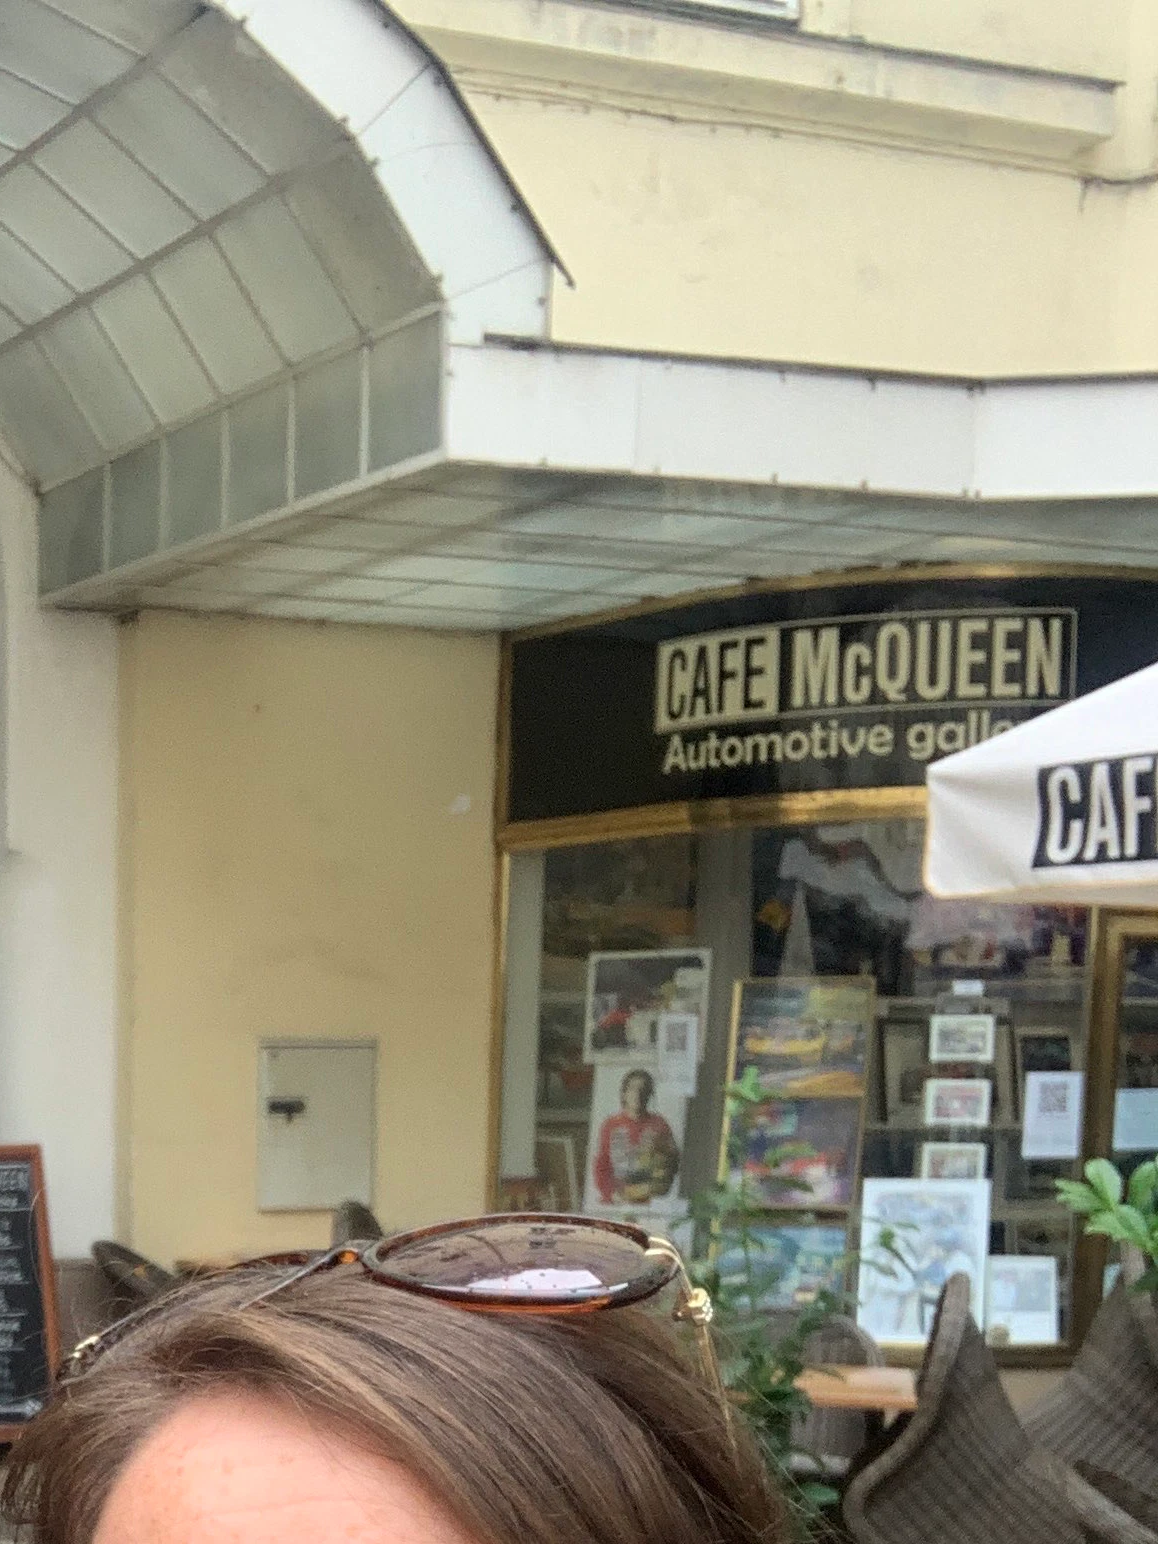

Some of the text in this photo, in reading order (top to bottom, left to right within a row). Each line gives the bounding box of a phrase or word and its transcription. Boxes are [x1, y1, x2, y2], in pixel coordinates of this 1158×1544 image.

[666, 615, 1063, 721] CAFE McQUEEN
[662, 718, 895, 776] Automotive
[1045, 755, 1158, 865] CAF
